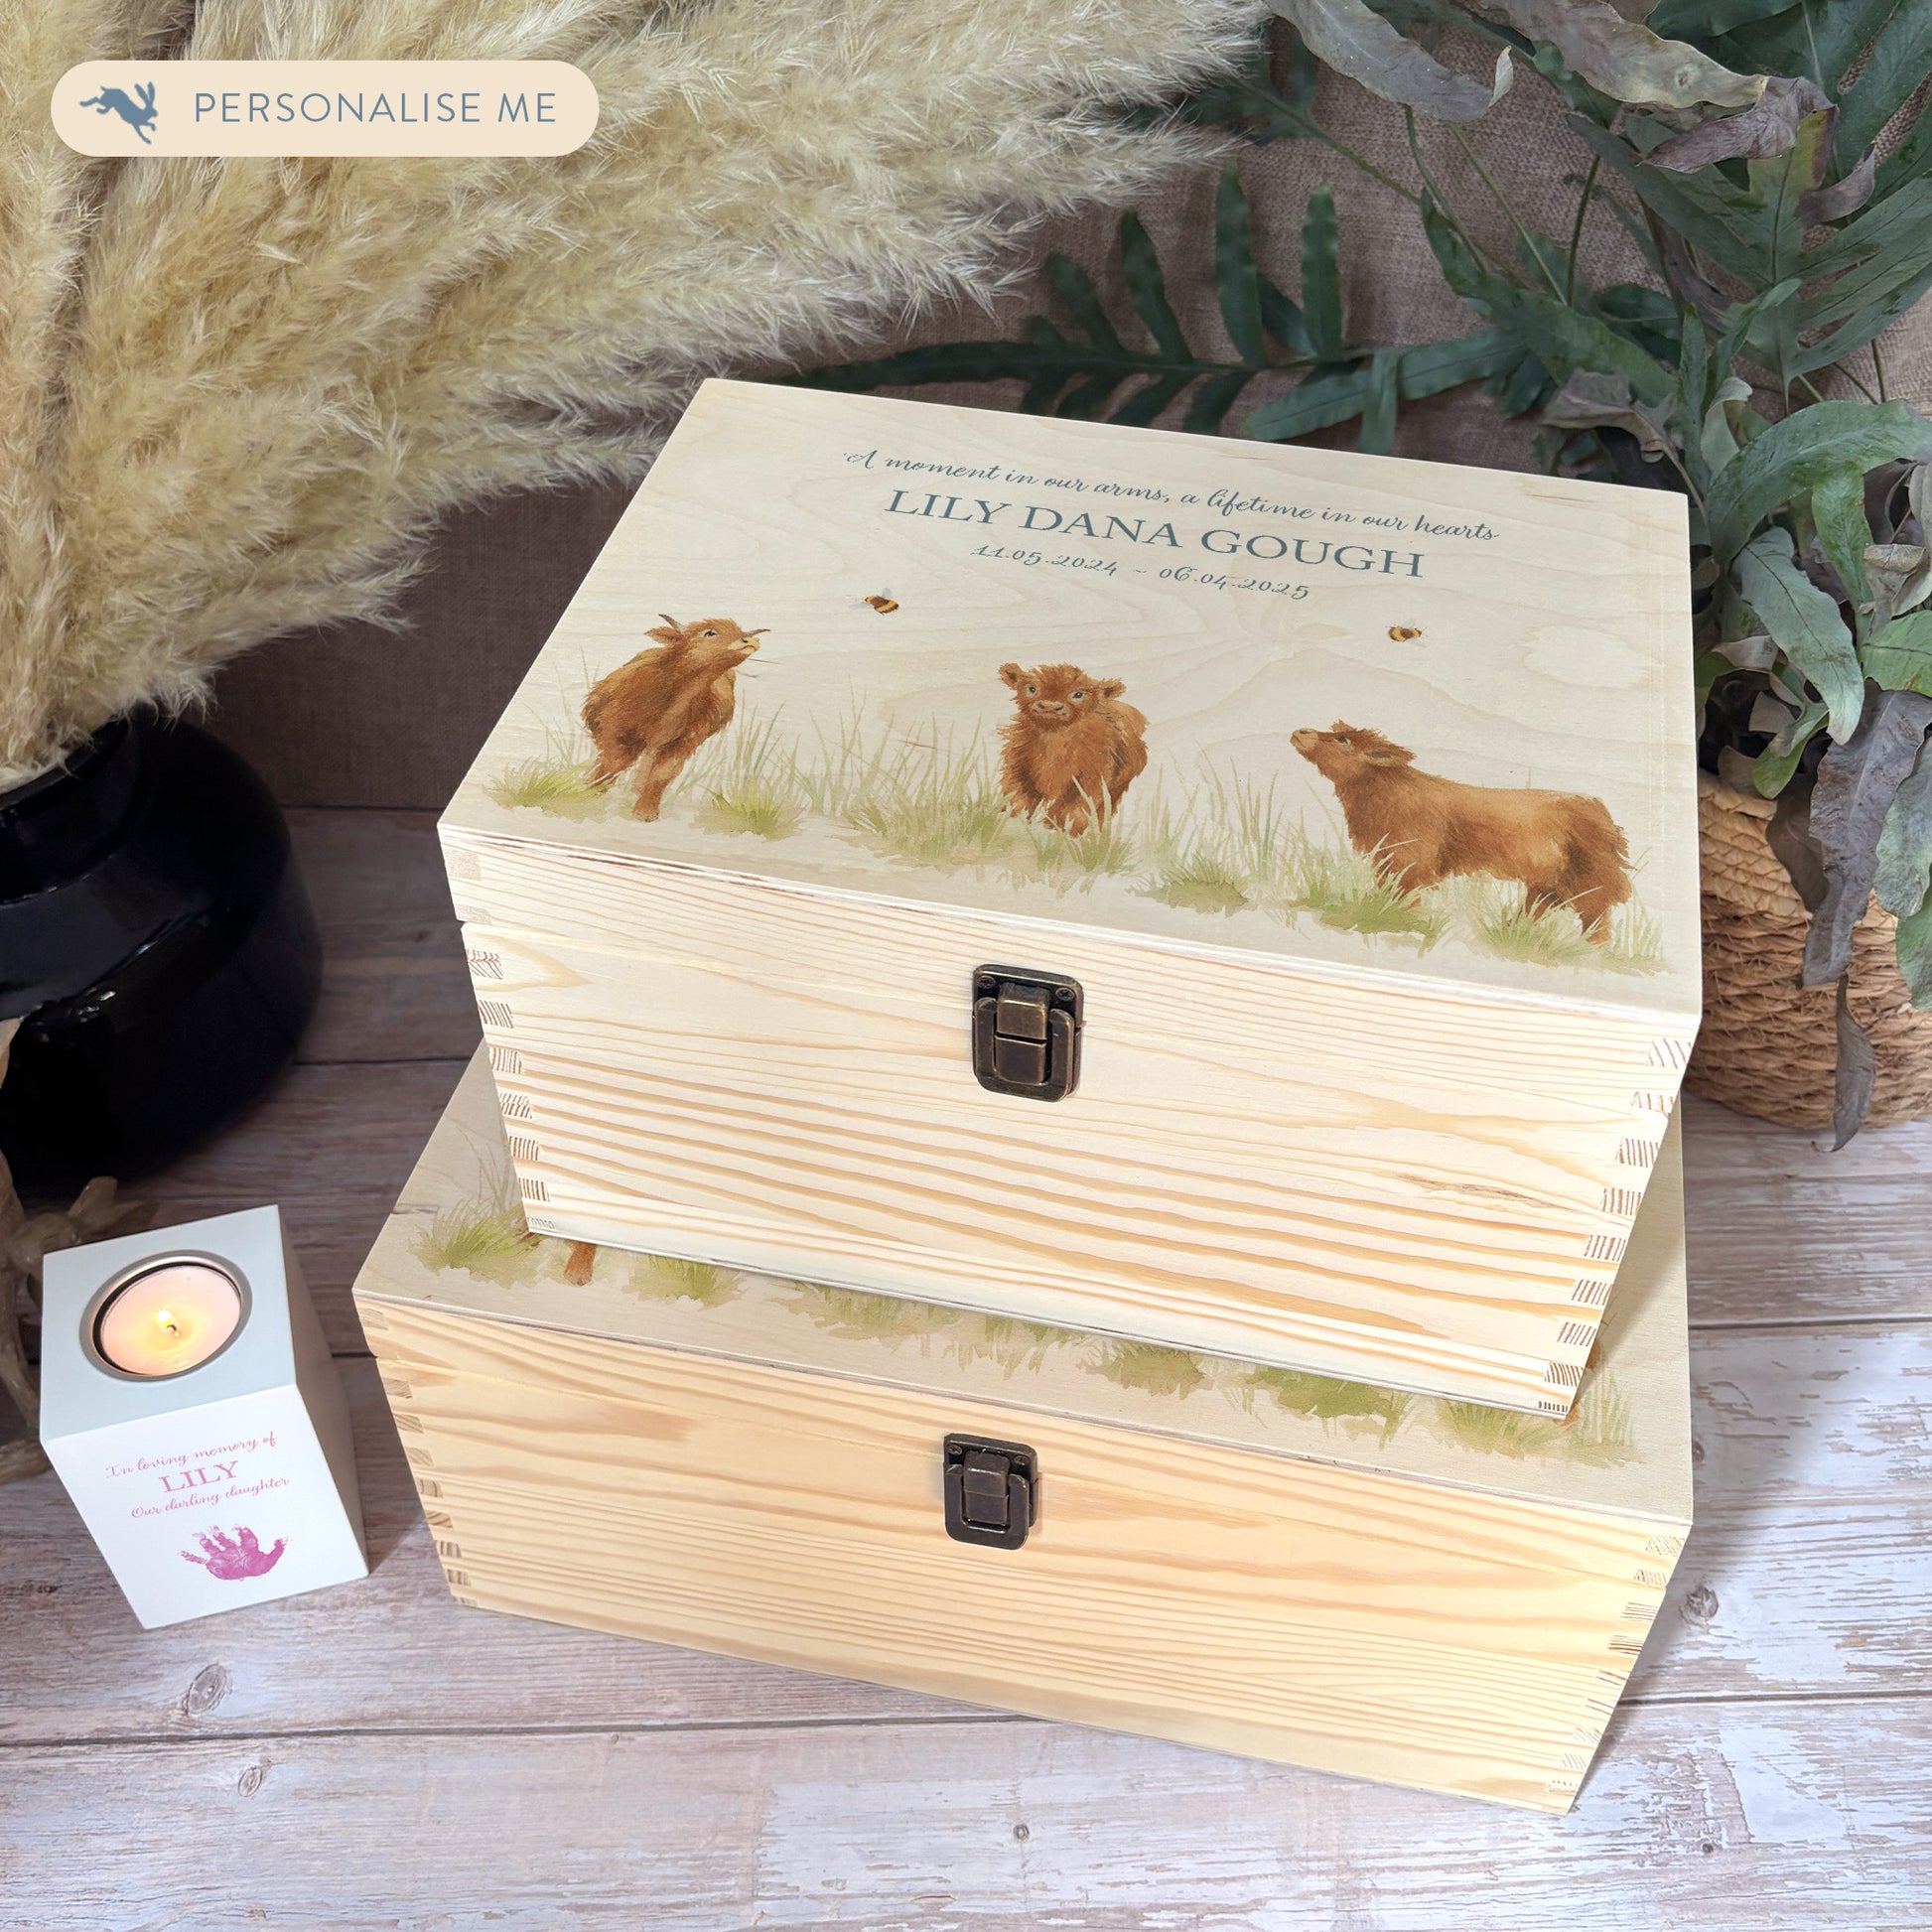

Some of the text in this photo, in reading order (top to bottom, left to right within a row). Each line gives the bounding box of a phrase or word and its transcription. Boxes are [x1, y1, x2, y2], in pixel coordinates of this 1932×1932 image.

[843, 450, 1500, 541] A moment in our arms, a lifetime in our hearts
[884, 489, 1425, 578] LILY DANA GOUGH
[970, 545, 1118, 577] 11.05.2024
[1159, 566, 1310, 601] 06.04.2025
[105, 1431, 277, 1478] In loving memory of
[158, 1460, 239, 1493] LILY
[131, 1476, 290, 1518] Our darling daughter
